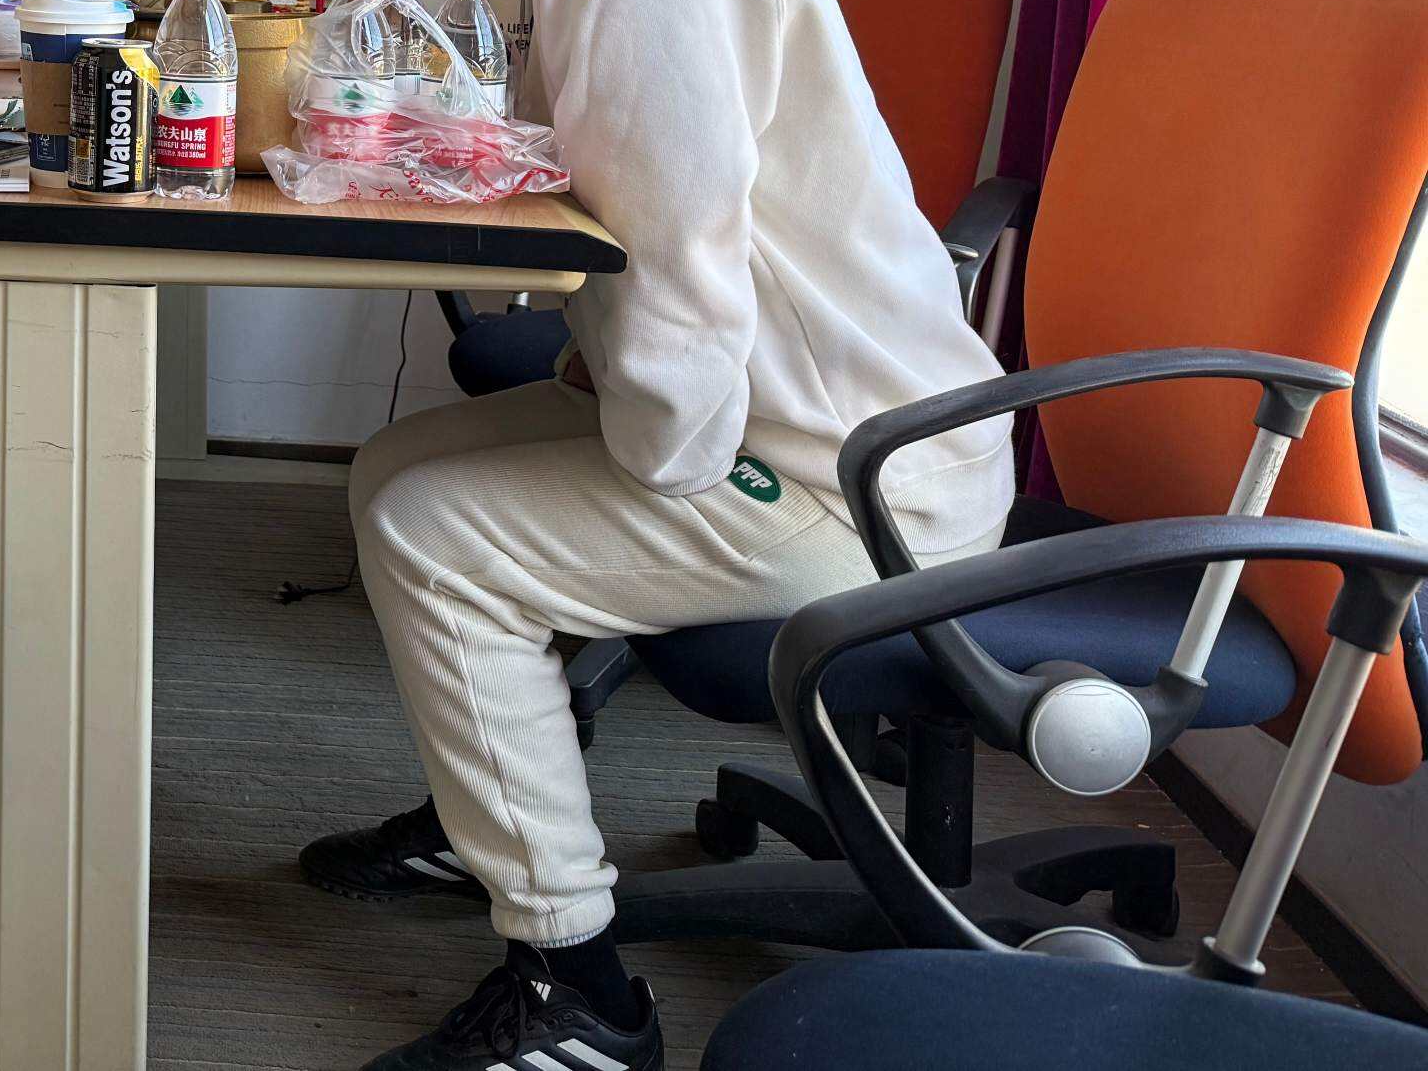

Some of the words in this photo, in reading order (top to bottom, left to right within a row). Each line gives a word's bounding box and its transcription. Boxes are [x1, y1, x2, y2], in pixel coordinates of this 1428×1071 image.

[102, 70, 133, 187] Watson's
[157, 125, 207, 142] 农夫山泉
